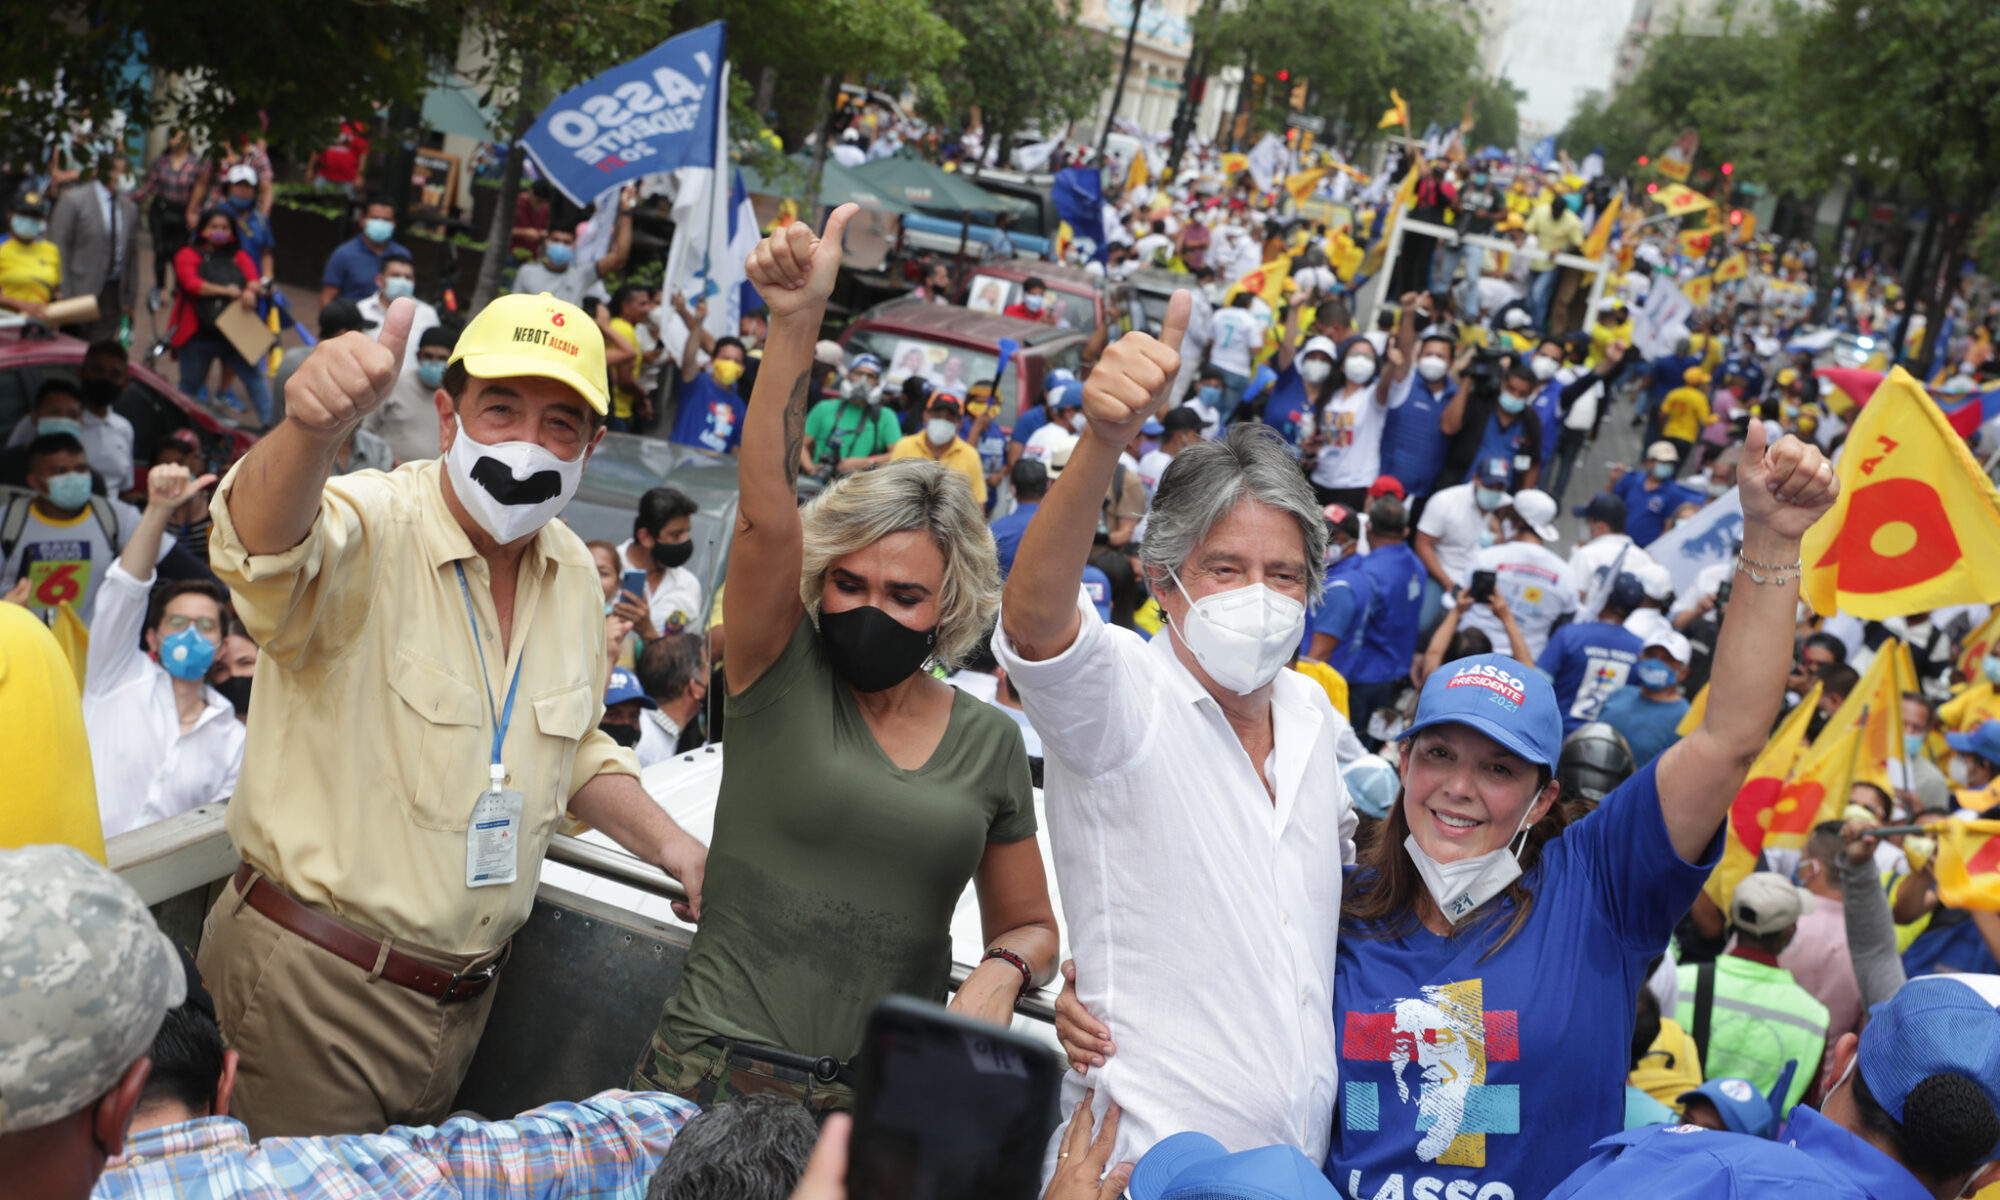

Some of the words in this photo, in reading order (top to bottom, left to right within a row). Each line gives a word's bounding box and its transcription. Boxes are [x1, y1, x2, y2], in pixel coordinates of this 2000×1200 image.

[552, 312, 565, 327] 6
[512, 326, 550, 346] NEBOT
[36, 565, 82, 606] 6
[1449, 675, 1522, 702] PRESIDENTE
[1454, 664, 1525, 692] LASSO
[1488, 692, 1519, 713] 2021
[1456, 896, 1474, 915] 21
